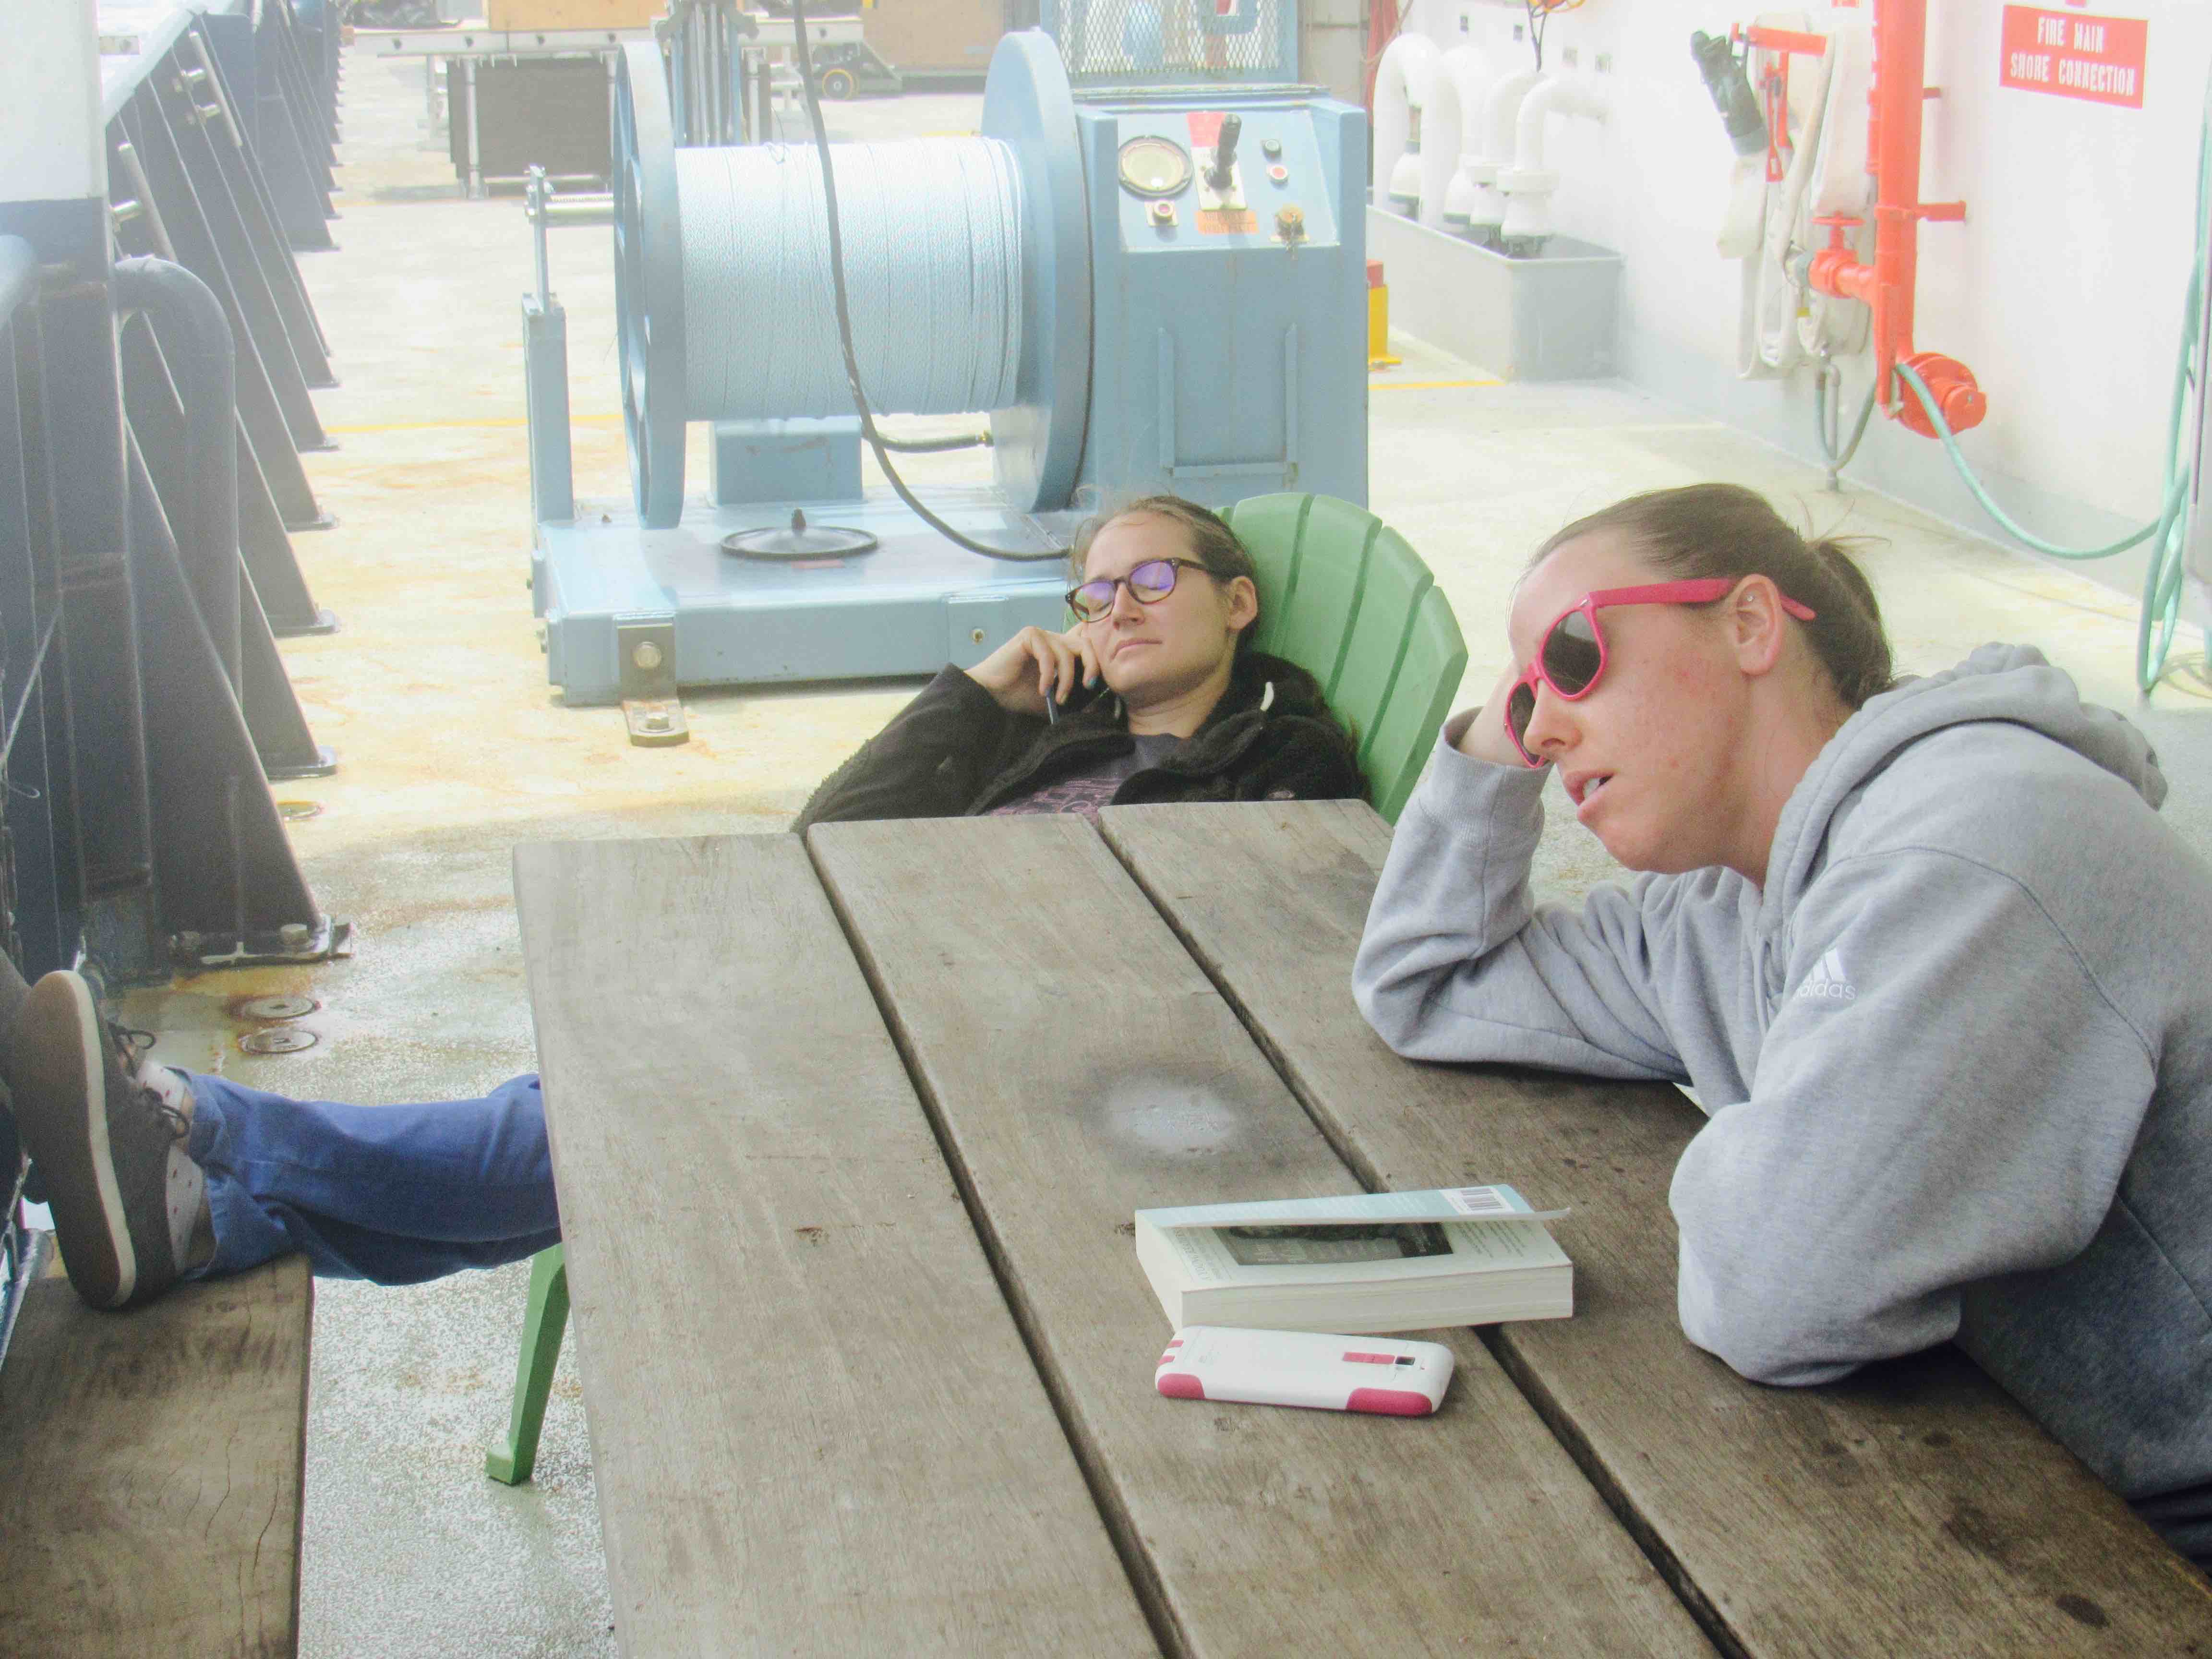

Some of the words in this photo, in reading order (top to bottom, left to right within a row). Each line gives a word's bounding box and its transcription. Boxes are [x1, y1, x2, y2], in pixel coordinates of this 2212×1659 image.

[2037, 17, 2066, 47] FIRE
[2074, 23, 2105, 53] MAIN
[2010, 52, 2051, 83] SHORE
[2058, 59, 2136, 96] CONNECTION
